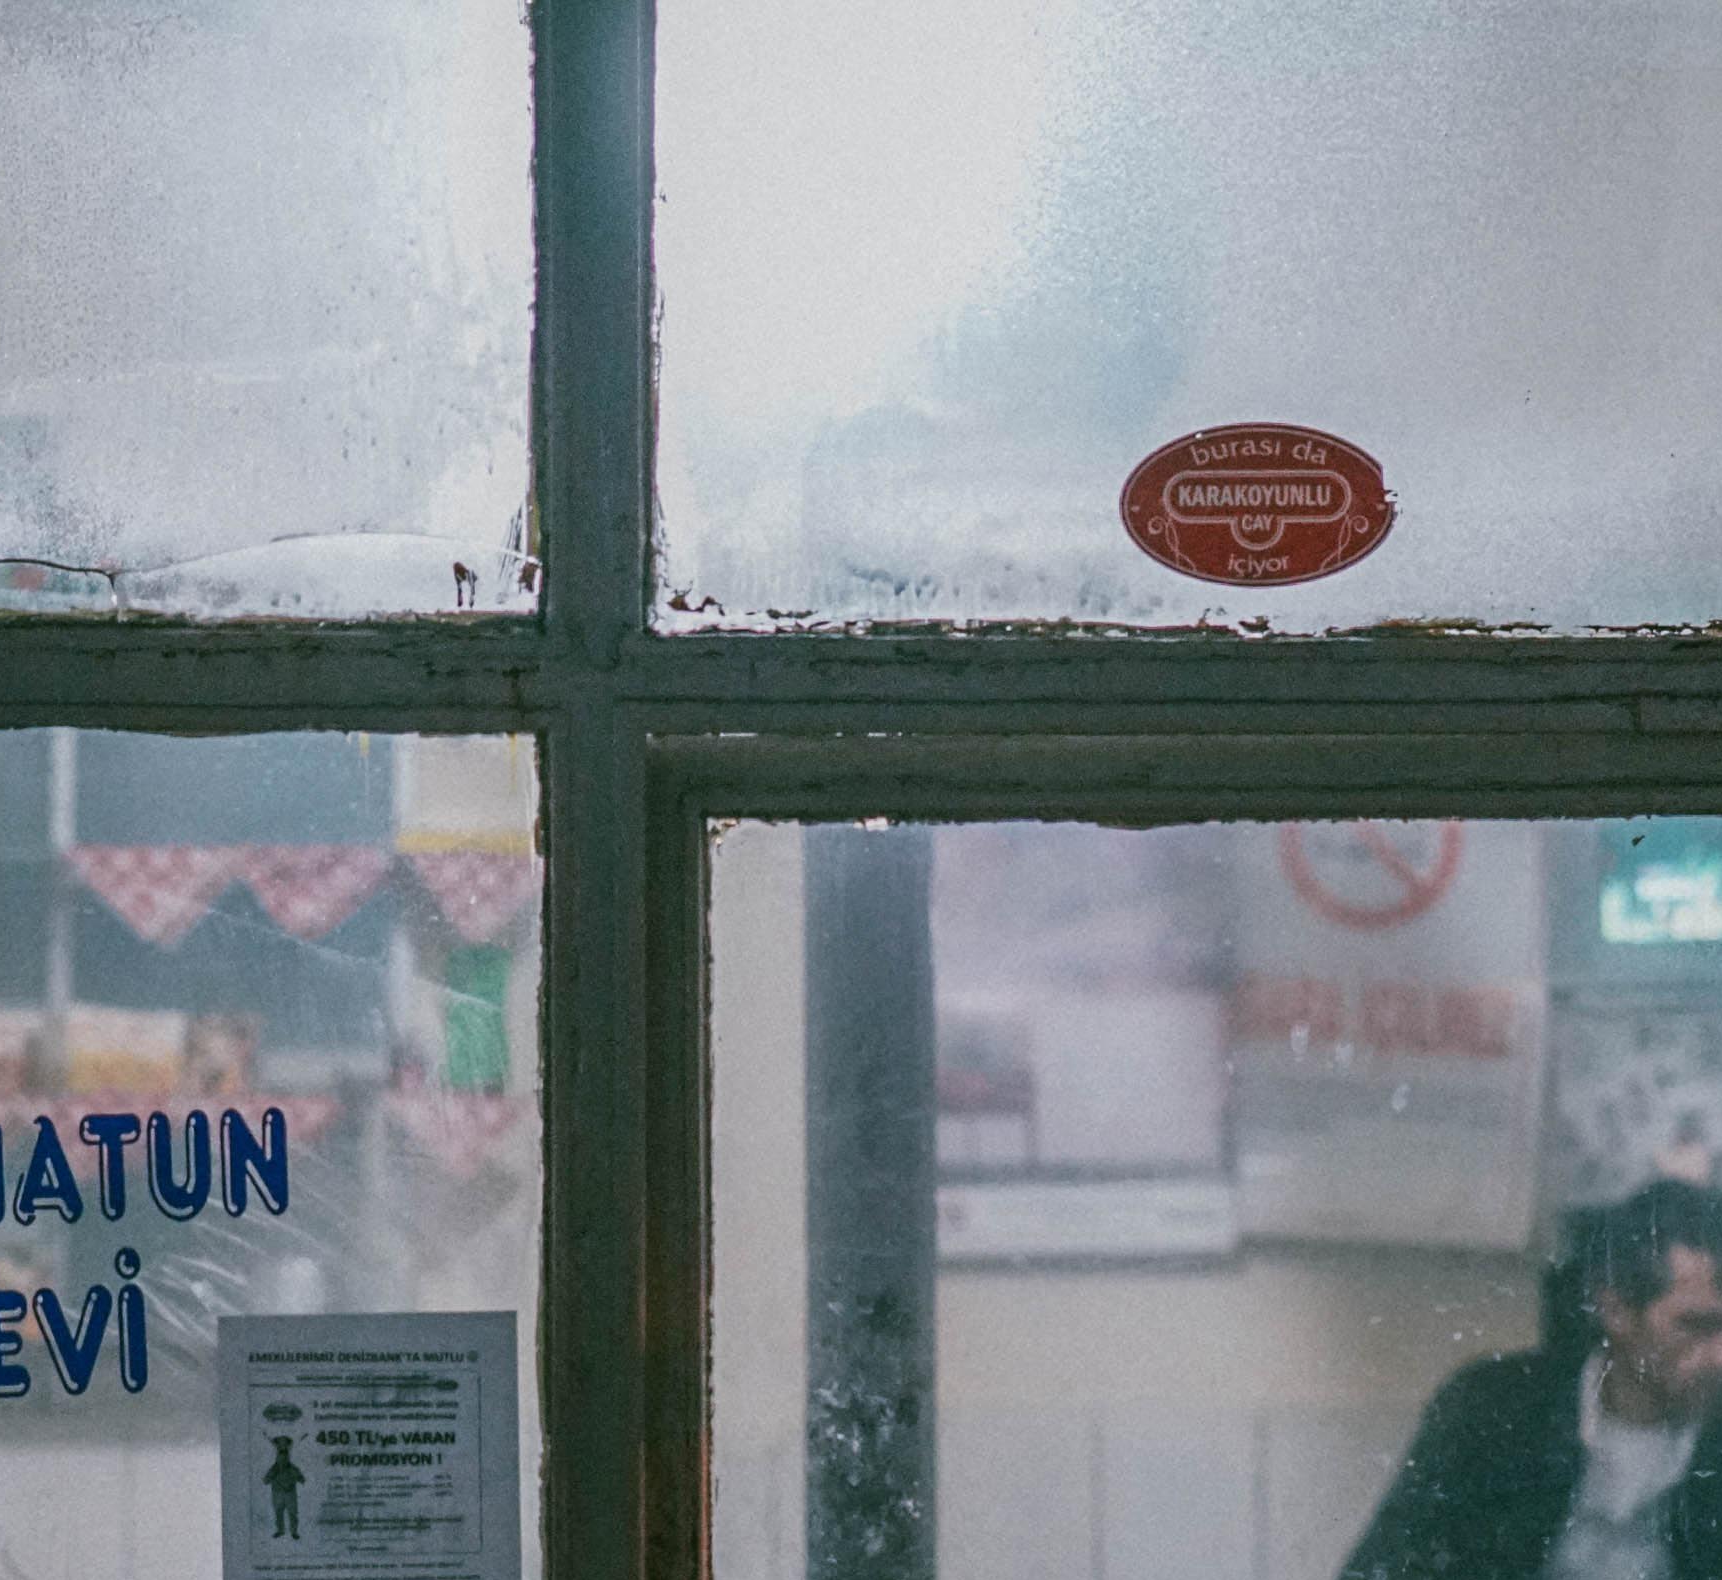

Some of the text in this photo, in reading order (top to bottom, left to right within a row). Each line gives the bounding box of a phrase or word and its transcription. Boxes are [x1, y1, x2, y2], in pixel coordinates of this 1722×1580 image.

[1189, 438, 1328, 466] burası da
[1177, 484, 1333, 507] KARAKOYUNLU
[1227, 553, 1290, 578] içiyor
[315, 1431, 351, 1445] 450
[401, 1431, 456, 1445] VARAN
[329, 1453, 433, 1466] PROMOSYON
